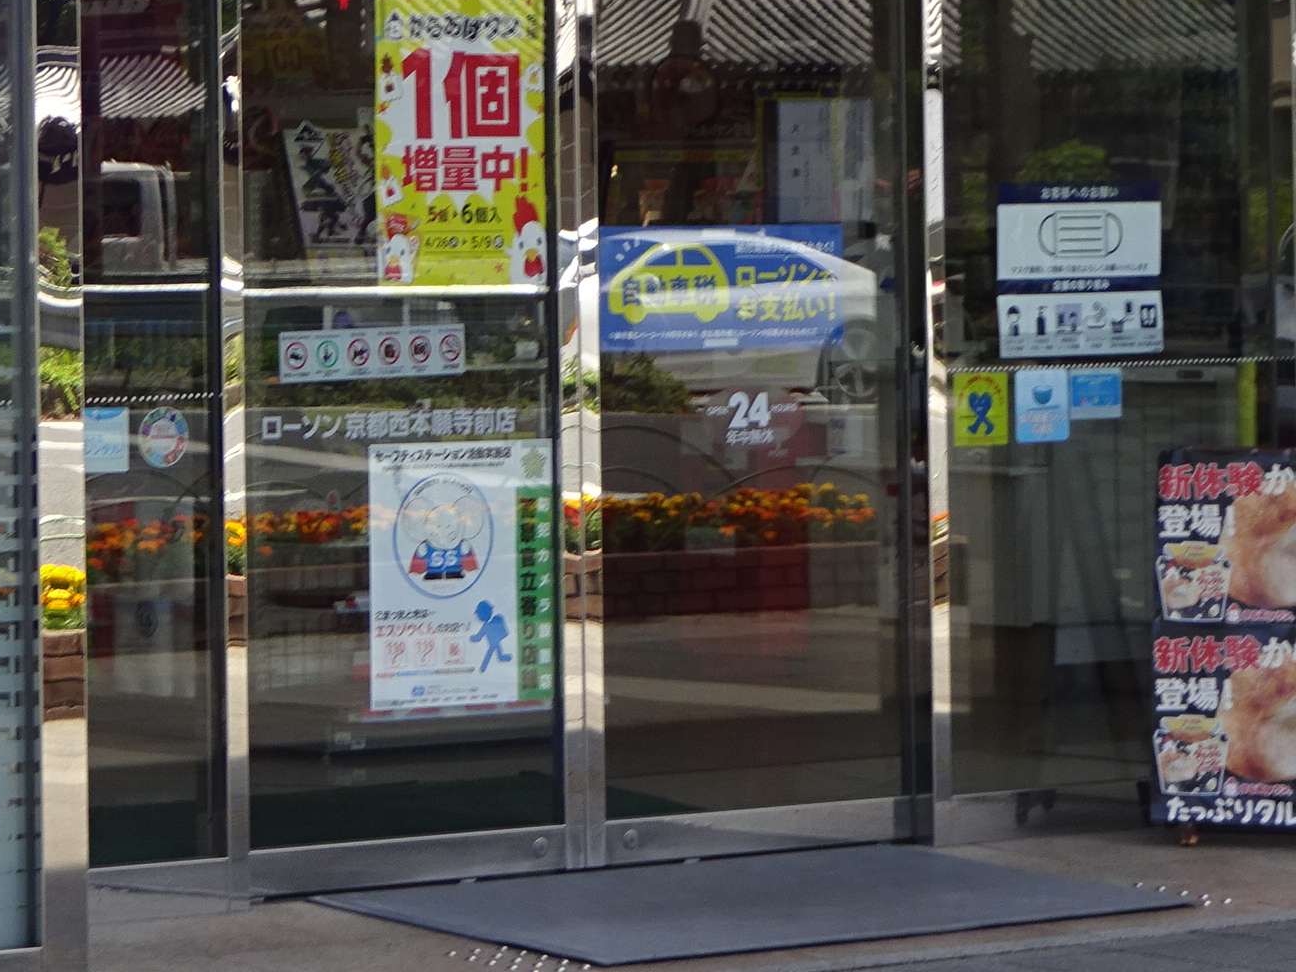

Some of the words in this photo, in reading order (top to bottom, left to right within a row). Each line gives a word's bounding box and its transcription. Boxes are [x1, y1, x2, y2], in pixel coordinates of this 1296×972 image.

[401, 47, 521, 140] 1個
[401, 144, 531, 193] 増量中!
[621, 273, 718, 308] 自動車税
[736, 292, 837, 321] お支払い!
[261, 407, 518, 441] ローソン京都西本願寺前店
[727, 391, 771, 429] 24
[1158, 461, 1296, 501] 新体験か
[1158, 503, 1237, 539] 登場!
[1154, 676, 1235, 713] 登場!
